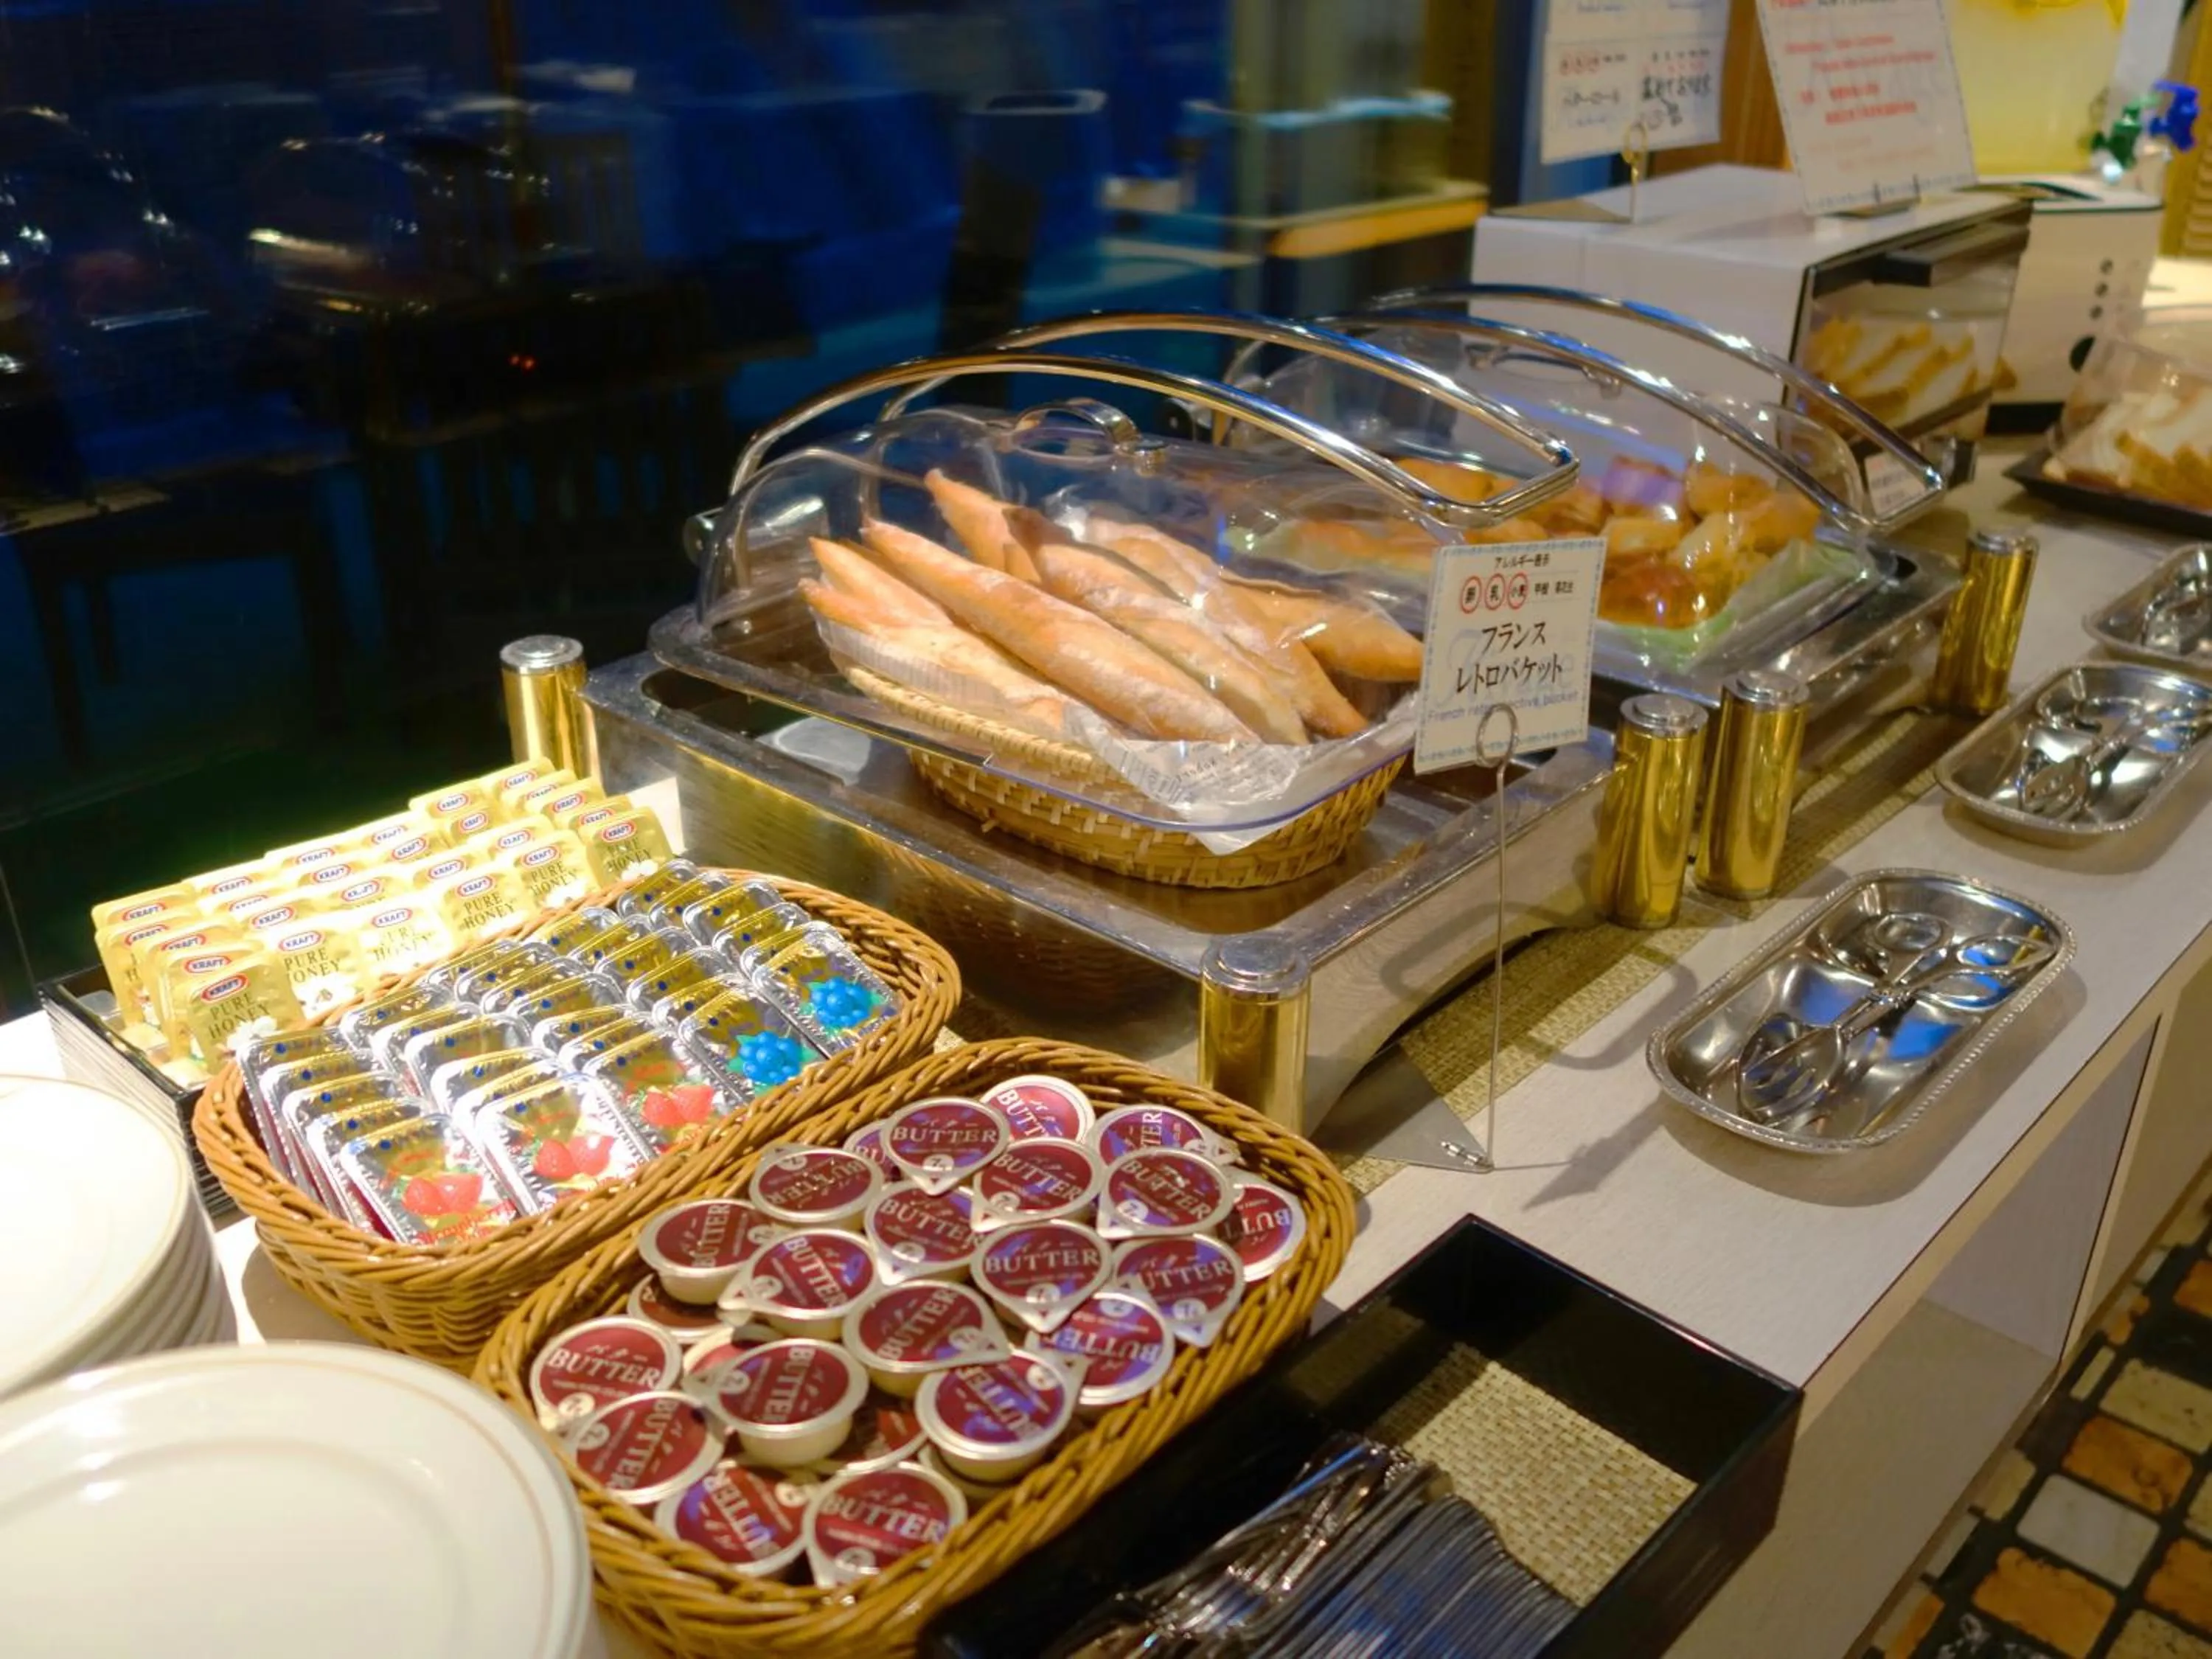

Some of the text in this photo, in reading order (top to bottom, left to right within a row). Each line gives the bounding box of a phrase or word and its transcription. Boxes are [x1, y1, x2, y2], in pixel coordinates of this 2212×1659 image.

[1481, 622, 1547, 655] フランス
[608, 824, 630, 838] KRAFT
[319, 867, 346, 880] KRAFT
[433, 863, 459, 876] KRAFT
[530, 860, 564, 883] PURE
[462, 879, 488, 894] KRAFT
[128, 905, 160, 920] KRAFT
[258, 909, 288, 925] KRAFT
[378, 911, 406, 924] KRAFT
[462, 891, 504, 915] PURE
[462, 902, 515, 931] HONEY
[285, 934, 317, 949] KRAFT
[191, 959, 225, 970] KRAFT
[283, 947, 329, 972] PURE
[288, 957, 342, 984] ONEY
[209, 979, 241, 996] KRAFT
[209, 992, 256, 1020] PURE
[207, 1004, 271, 1040] HONEY
[996, 1088, 1050, 1138] BUTT
[891, 1126, 998, 1144] BUTTER
[1141, 1111, 1163, 1146] TER
[766, 1159, 866, 1206] BUTTER
[992, 1151, 1083, 1201] BUTTER
[1121, 1160, 1213, 1221] BUTTER
[692, 1203, 731, 1269] BUTTER
[879, 1198, 985, 1251] BUTTER
[784, 1236, 849, 1310] BUTTER
[984, 1248, 1102, 1274] BUTTER
[1136, 1261, 1233, 1290] UTTER
[877, 1287, 959, 1360] BUTTER
[548, 1347, 662, 1391] BUTTER
[754, 1346, 816, 1422] BUTTER
[605, 1398, 680, 1489] BUTTER
[703, 1472, 783, 1559] BUTTER
[820, 1495, 948, 1543] BUTTER
